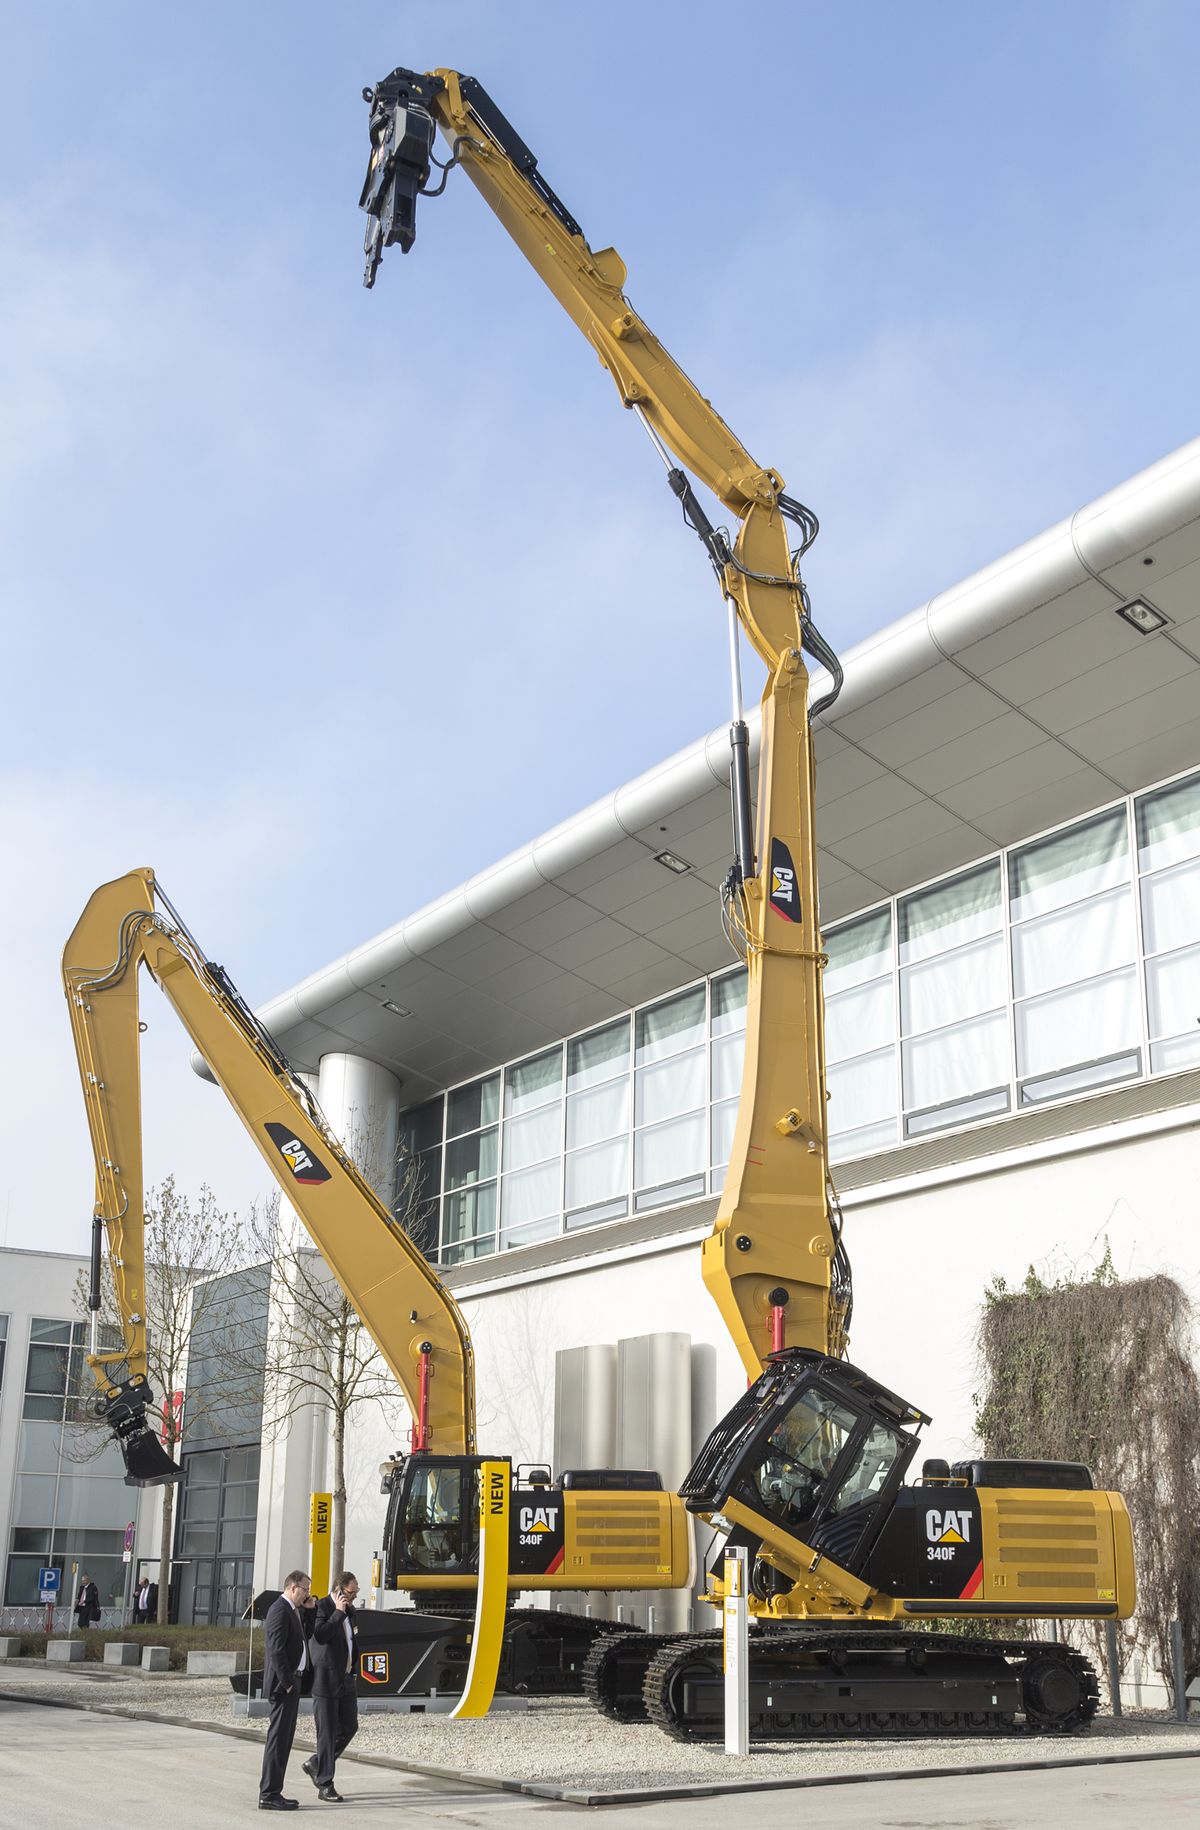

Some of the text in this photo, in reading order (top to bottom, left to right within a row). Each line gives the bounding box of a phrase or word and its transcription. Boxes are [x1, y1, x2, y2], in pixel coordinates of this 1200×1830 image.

[773, 866, 794, 903] CAT
[281, 1139, 313, 1173] CAT
[491, 1473, 504, 1515] NEW
[317, 1501, 328, 1534] NEW
[520, 1507, 559, 1532] CAT
[925, 1509, 973, 1543] CAT
[519, 1534, 543, 1545] 340F
[926, 1547, 956, 1560] 340F
[43, 1571, 56, 1588] P
[374, 1655, 386, 1675] CAT
